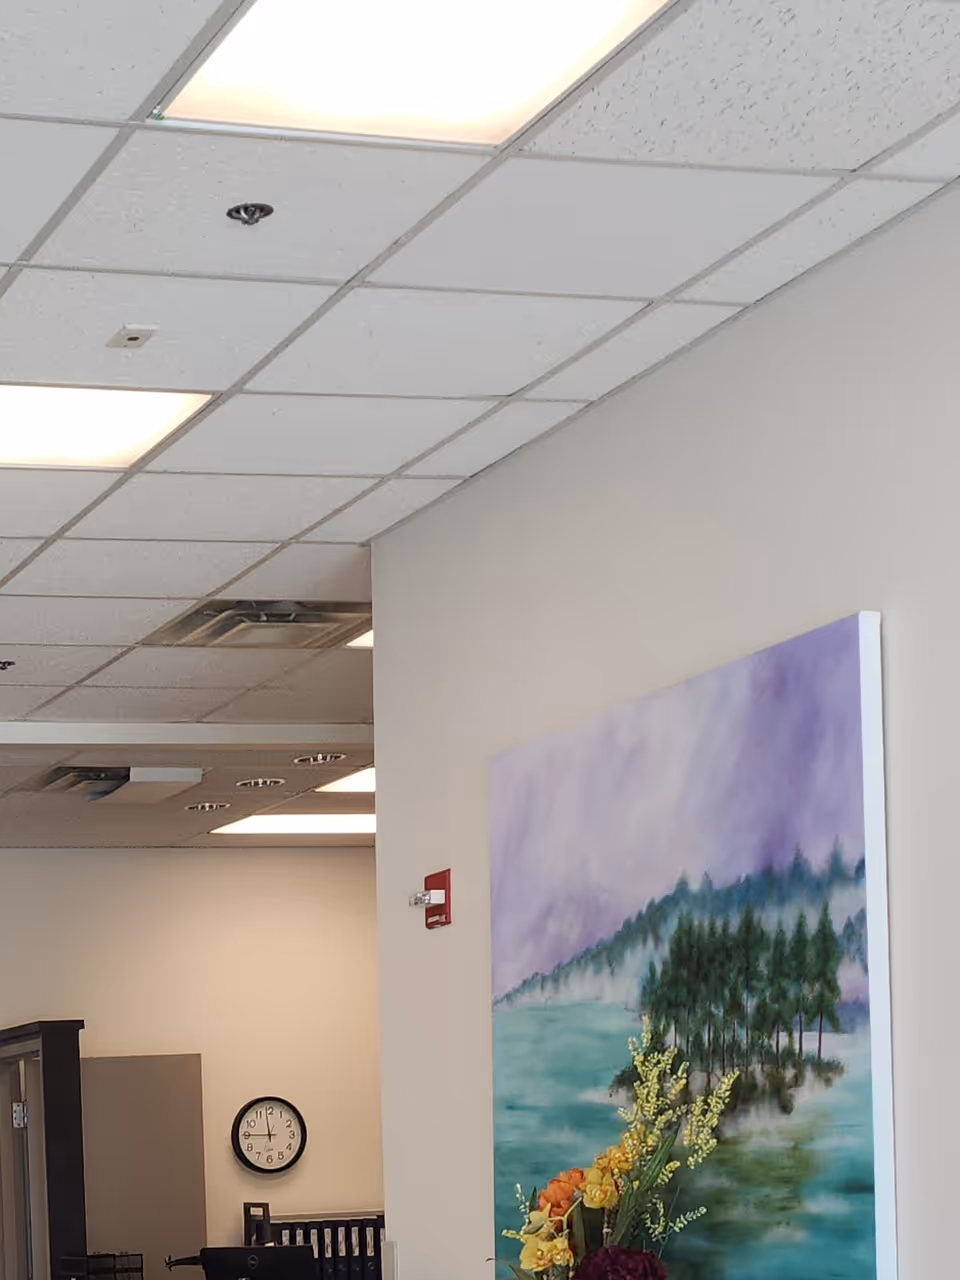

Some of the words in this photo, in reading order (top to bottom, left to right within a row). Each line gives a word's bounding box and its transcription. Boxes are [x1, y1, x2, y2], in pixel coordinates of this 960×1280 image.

[255, 1110, 262, 1119] 11
[246, 1119, 256, 1128] 10
[286, 1119, 292, 1128] 2
[289, 1130, 295, 1139] 3
[247, 1143, 253, 1152] 8
[286, 1143, 292, 1151] 4
[256, 1152, 261, 1160] 7
[267, 1155, 273, 1163] 6
[277, 1151, 284, 1160] 5
